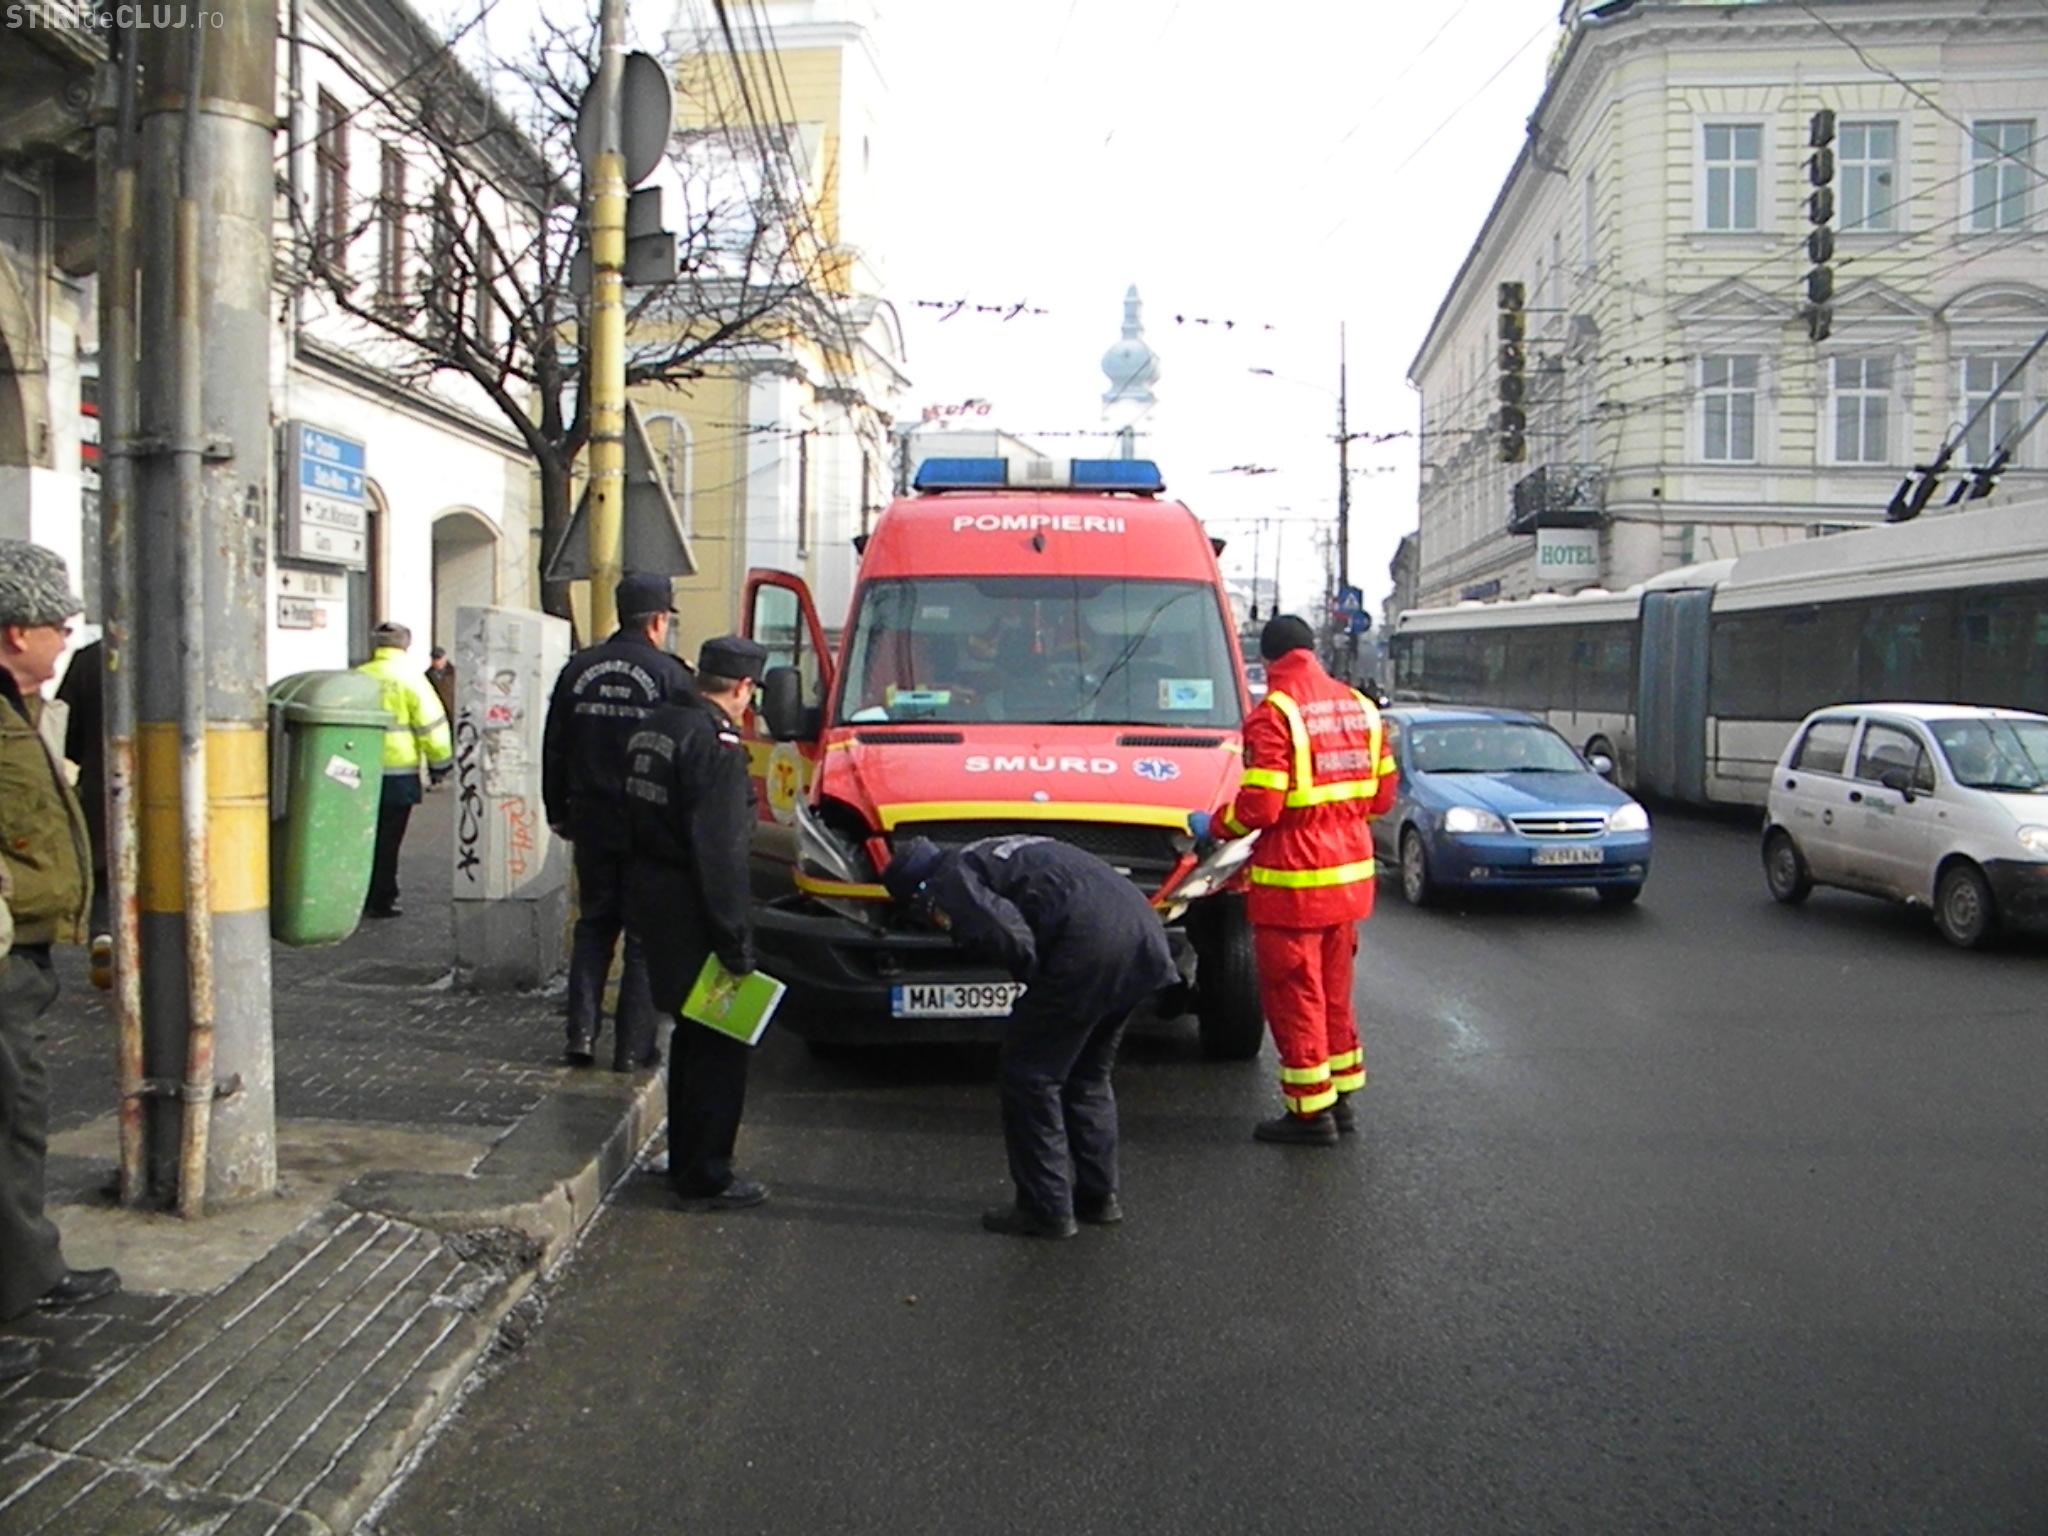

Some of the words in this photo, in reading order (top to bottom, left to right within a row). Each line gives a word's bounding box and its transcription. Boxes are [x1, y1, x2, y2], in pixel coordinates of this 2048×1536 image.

[953, 515, 1126, 533] POMPIERII
[1541, 545, 1597, 566] HOTEL
[965, 756, 1118, 774] SMURD
[910, 987, 944, 1009] MAI
